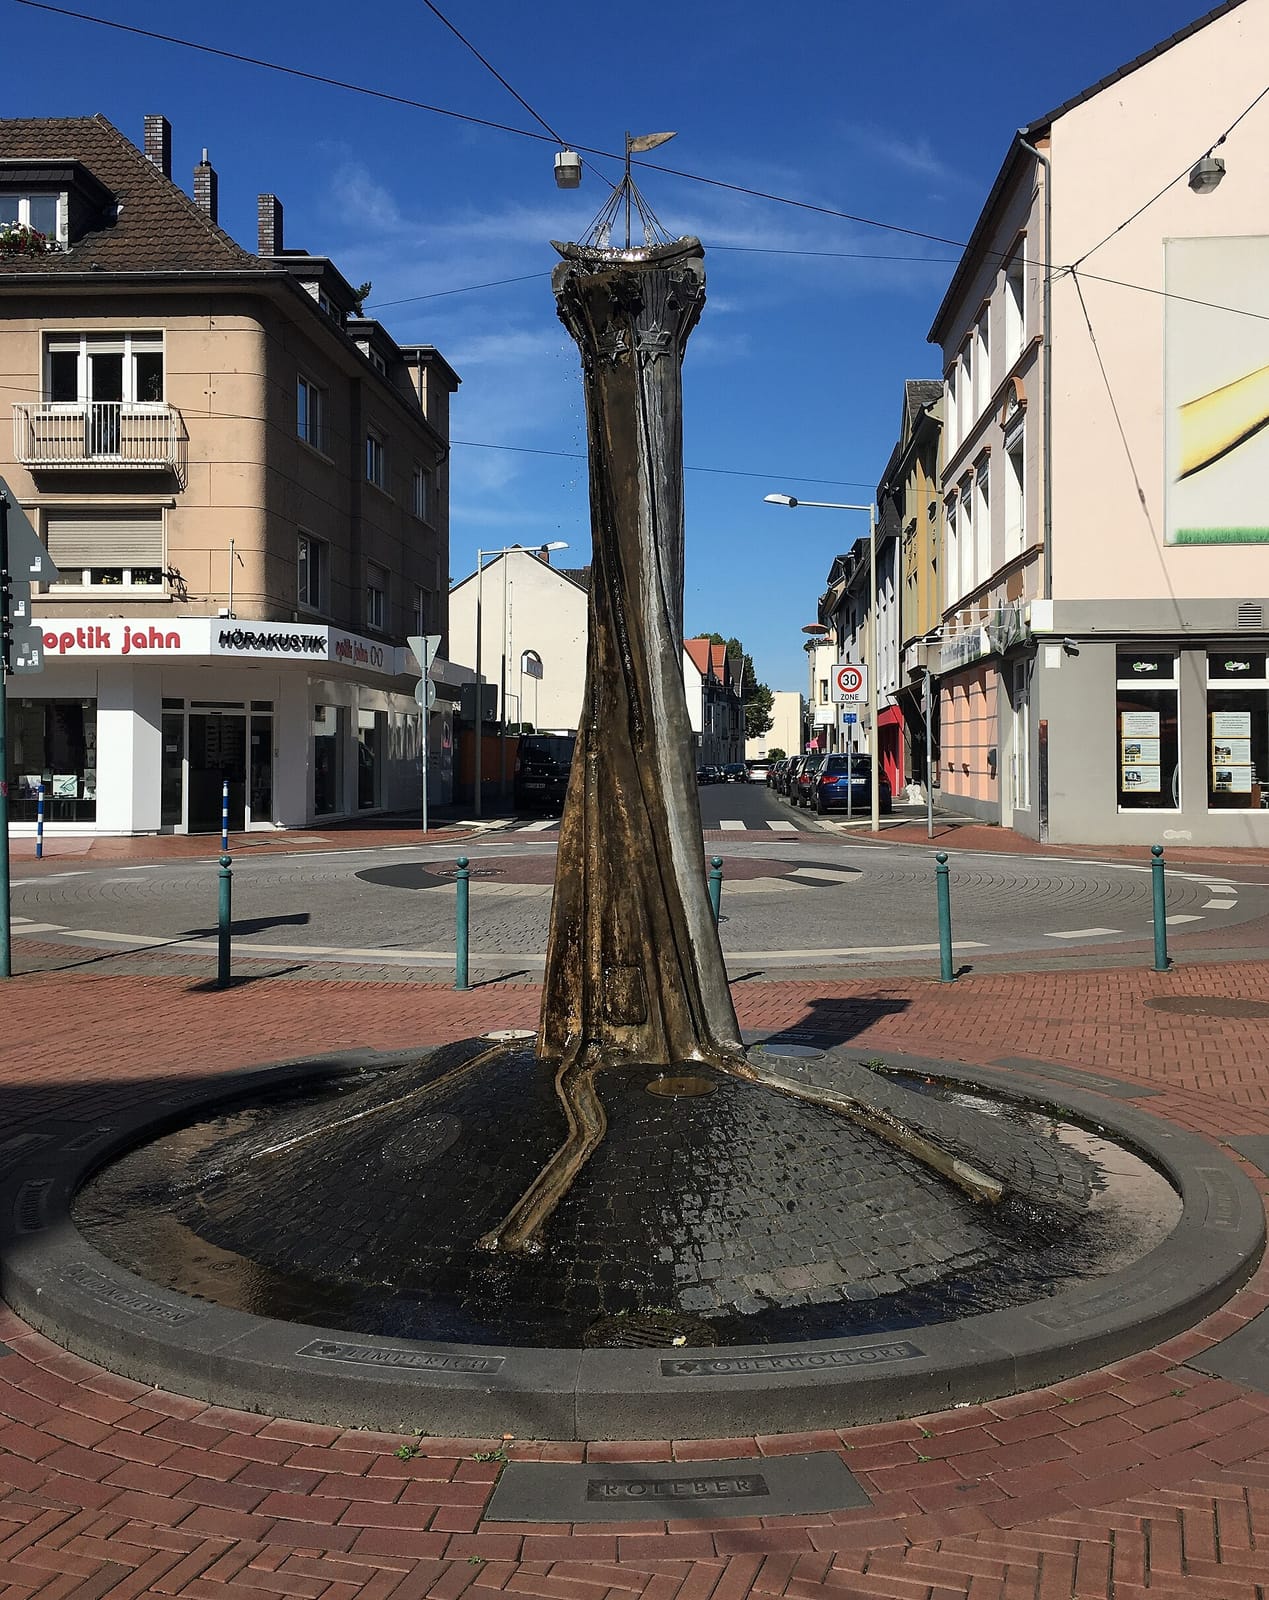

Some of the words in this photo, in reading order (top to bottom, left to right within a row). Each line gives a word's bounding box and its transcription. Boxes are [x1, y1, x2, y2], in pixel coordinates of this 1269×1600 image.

[43, 626, 111, 654] optik
[122, 626, 181, 654] jahn
[218, 628, 327, 652] HÖRAKUSTIK
[842, 674, 857, 686] 30
[712, 1347, 909, 1370] OBERHOLTORF
[605, 1479, 750, 1496] ROLEBER
